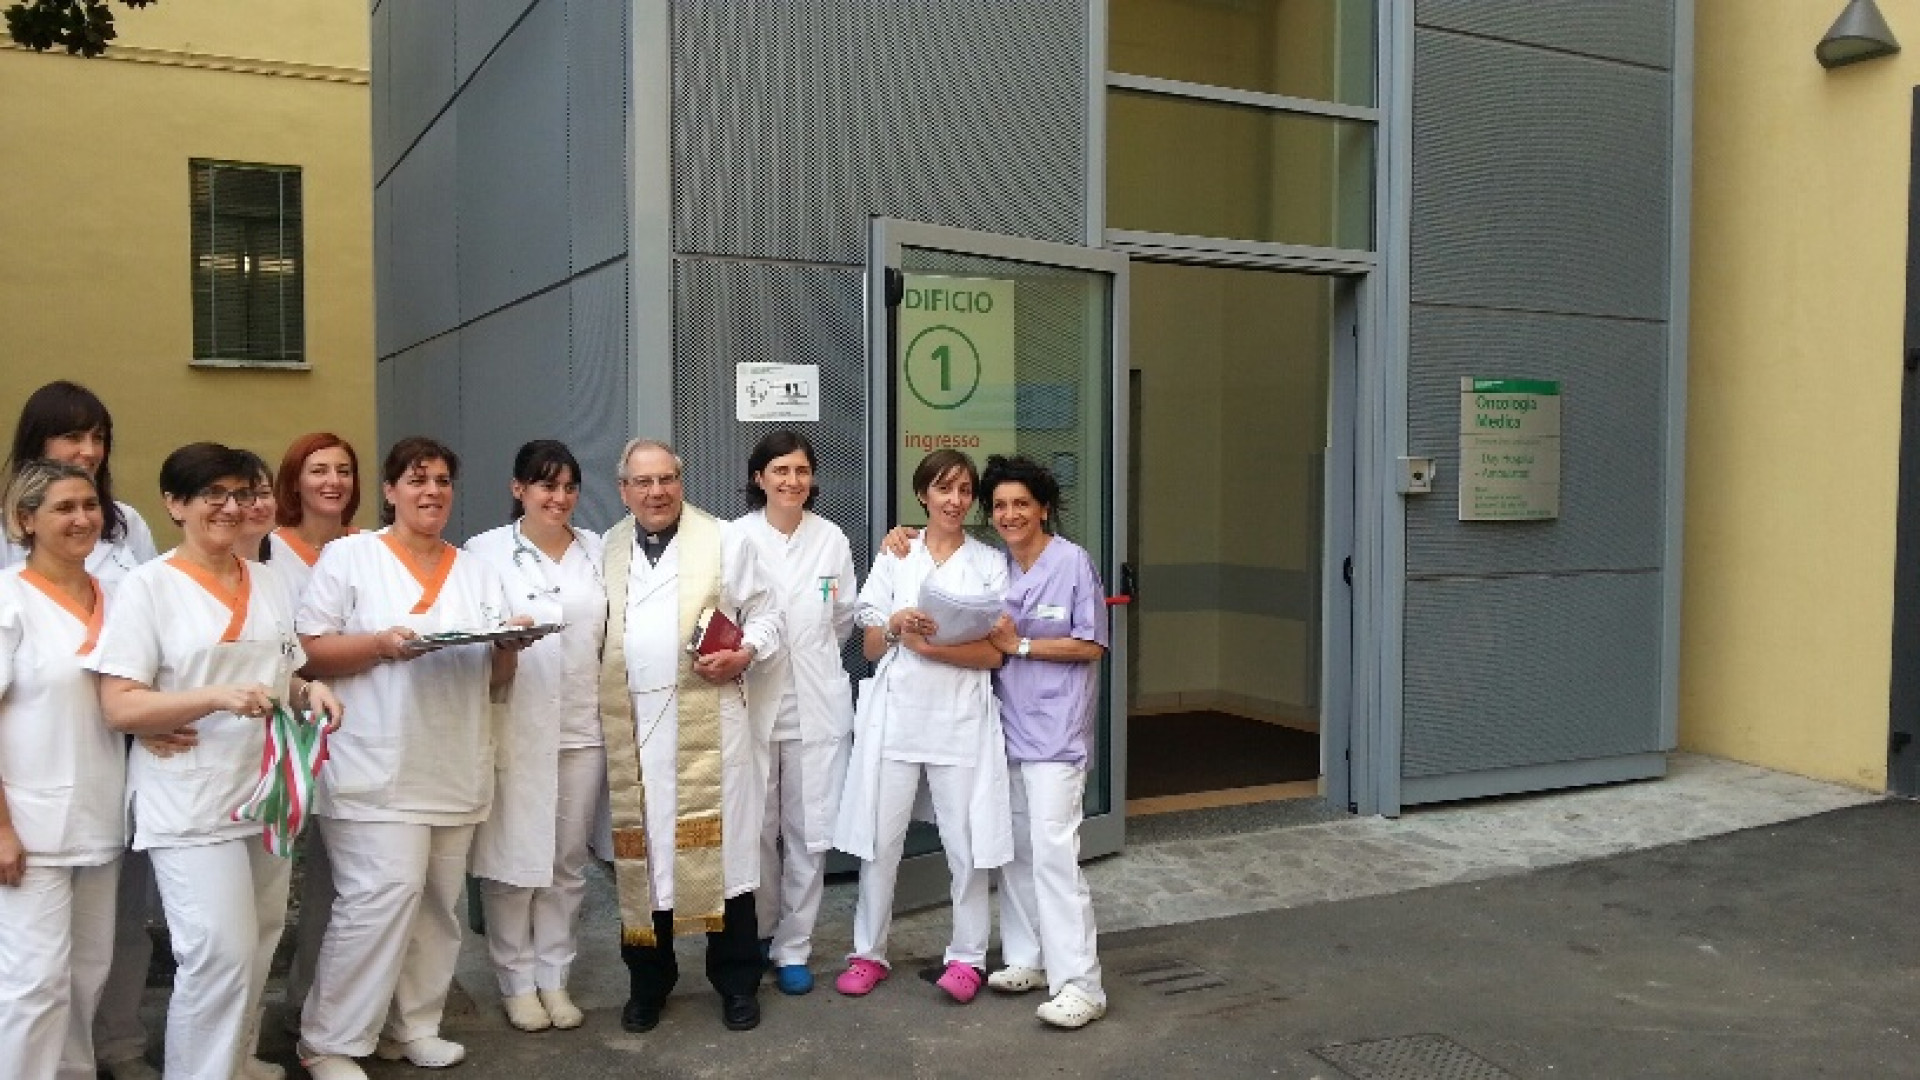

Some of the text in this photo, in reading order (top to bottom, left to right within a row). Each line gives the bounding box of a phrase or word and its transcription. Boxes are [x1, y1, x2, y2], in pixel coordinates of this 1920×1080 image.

[905, 288, 994, 314] DIFICIO
[931, 345, 951, 391] 1
[1475, 395, 1538, 414] Oncologia
[1475, 413, 1521, 429] Medica
[904, 430, 980, 452] ingresso
